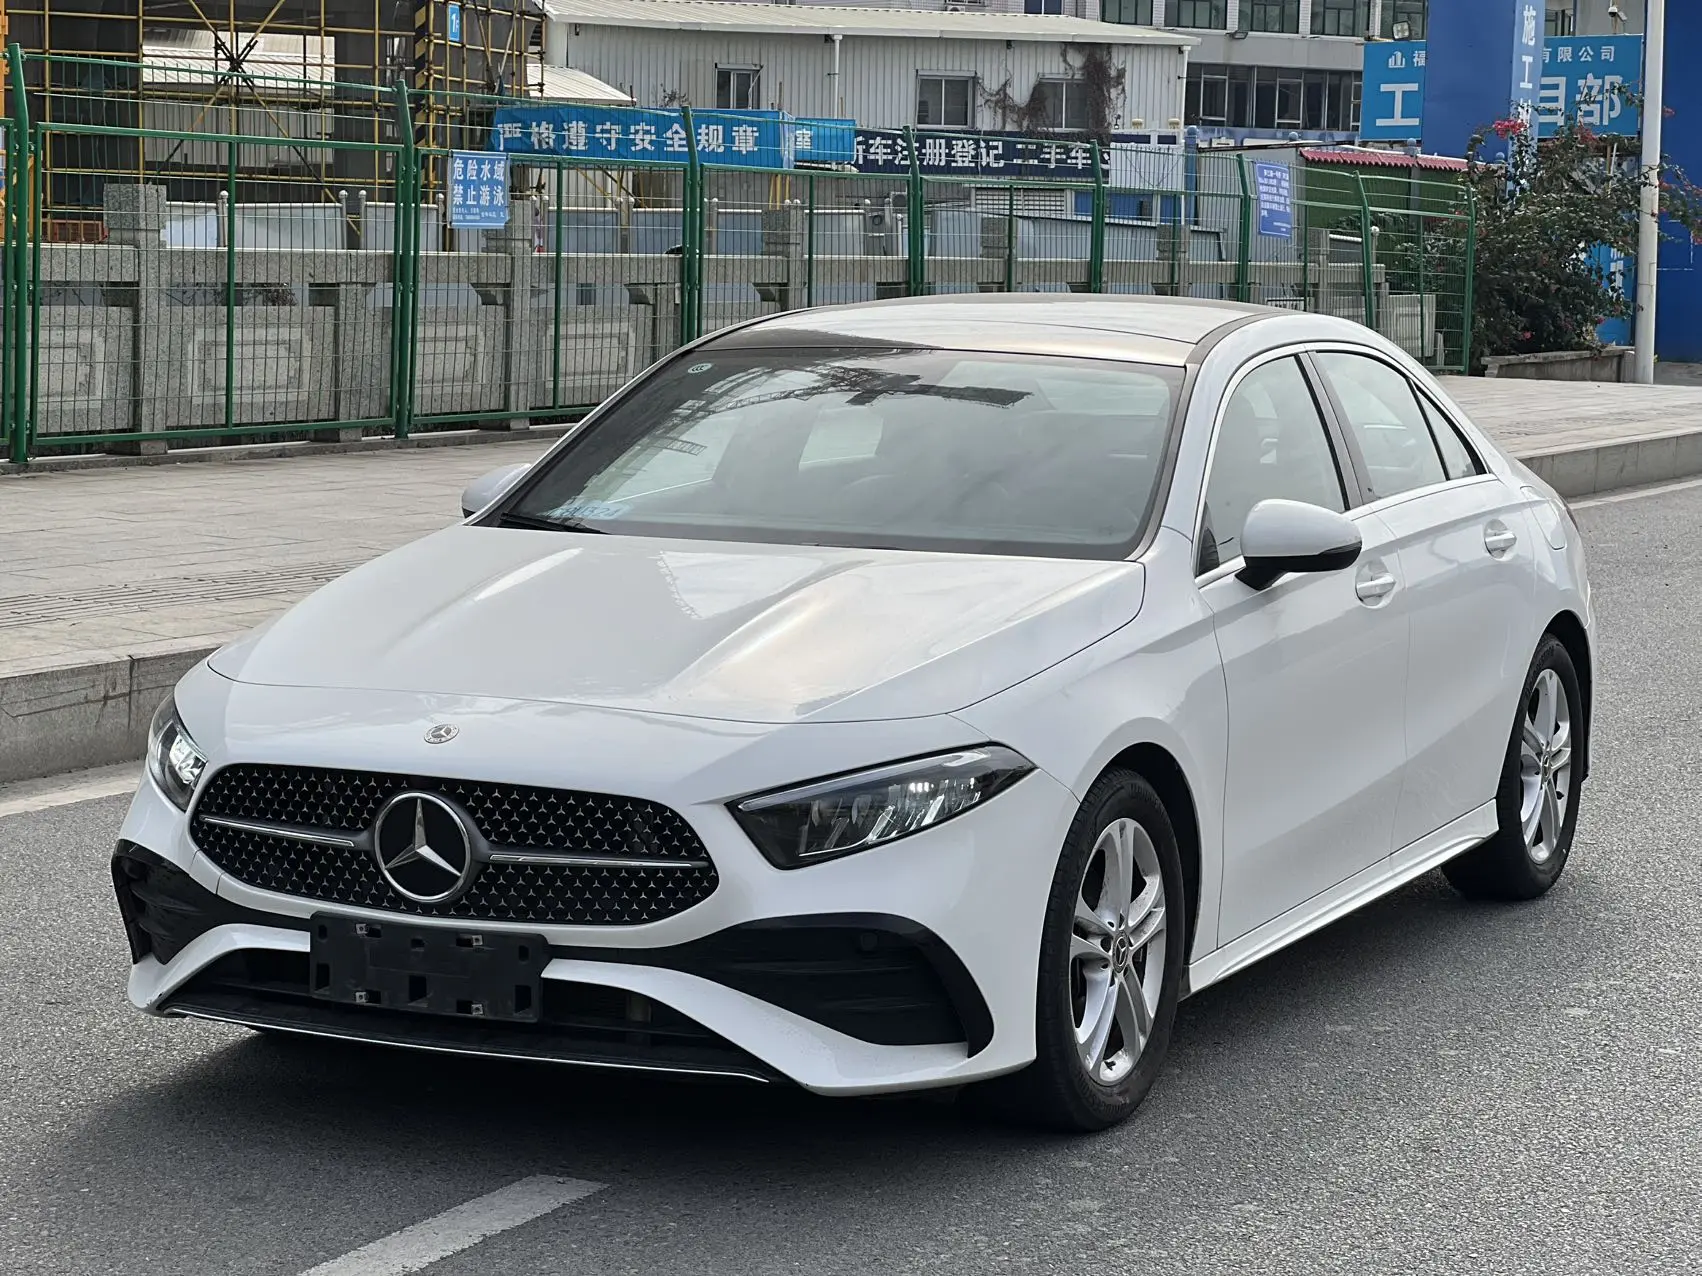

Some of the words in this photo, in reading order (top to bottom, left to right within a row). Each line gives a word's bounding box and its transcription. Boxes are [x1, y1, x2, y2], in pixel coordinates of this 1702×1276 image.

[1375, 83, 1420, 127] 工
[497, 120, 760, 155] 严格遵守安全规章
[453, 158, 505, 181] 危险水域
[453, 183, 505, 206] 禁止游泳
